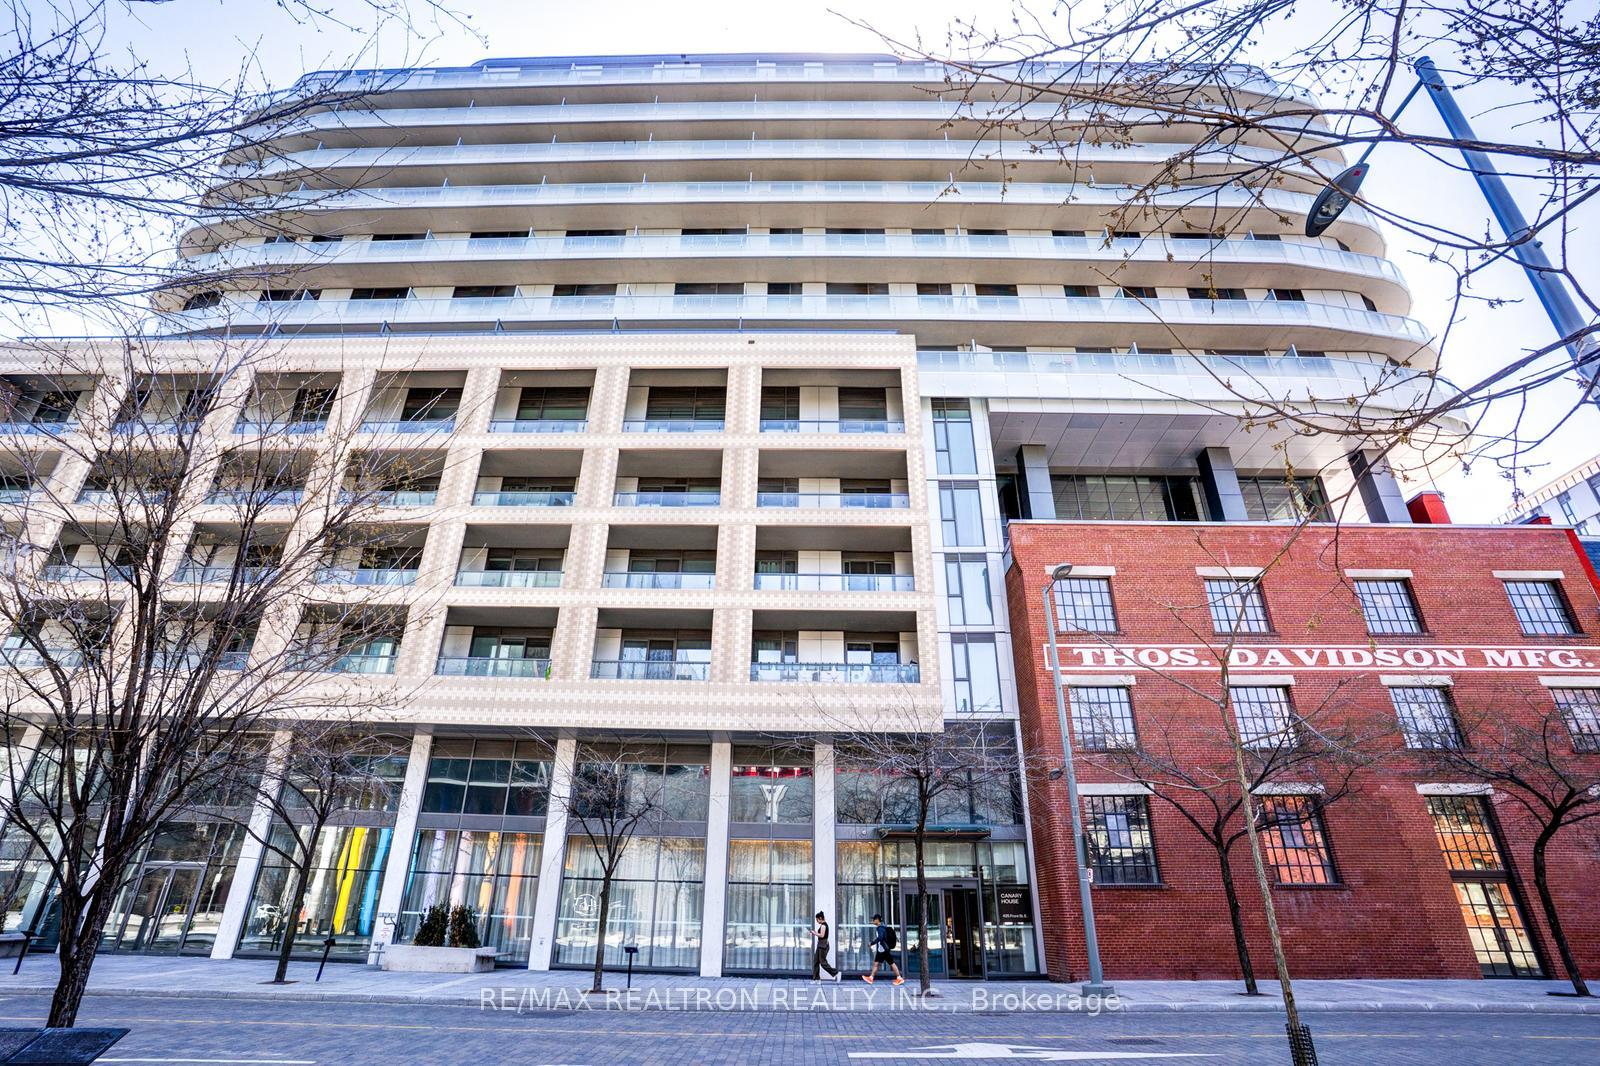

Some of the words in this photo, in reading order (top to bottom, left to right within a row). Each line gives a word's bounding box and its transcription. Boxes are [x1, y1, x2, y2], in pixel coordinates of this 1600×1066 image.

[1073, 648, 1210, 667] THOS.
[1227, 648, 1468, 668] DAVIDSON
[1480, 649, 1595, 668] MFG.
